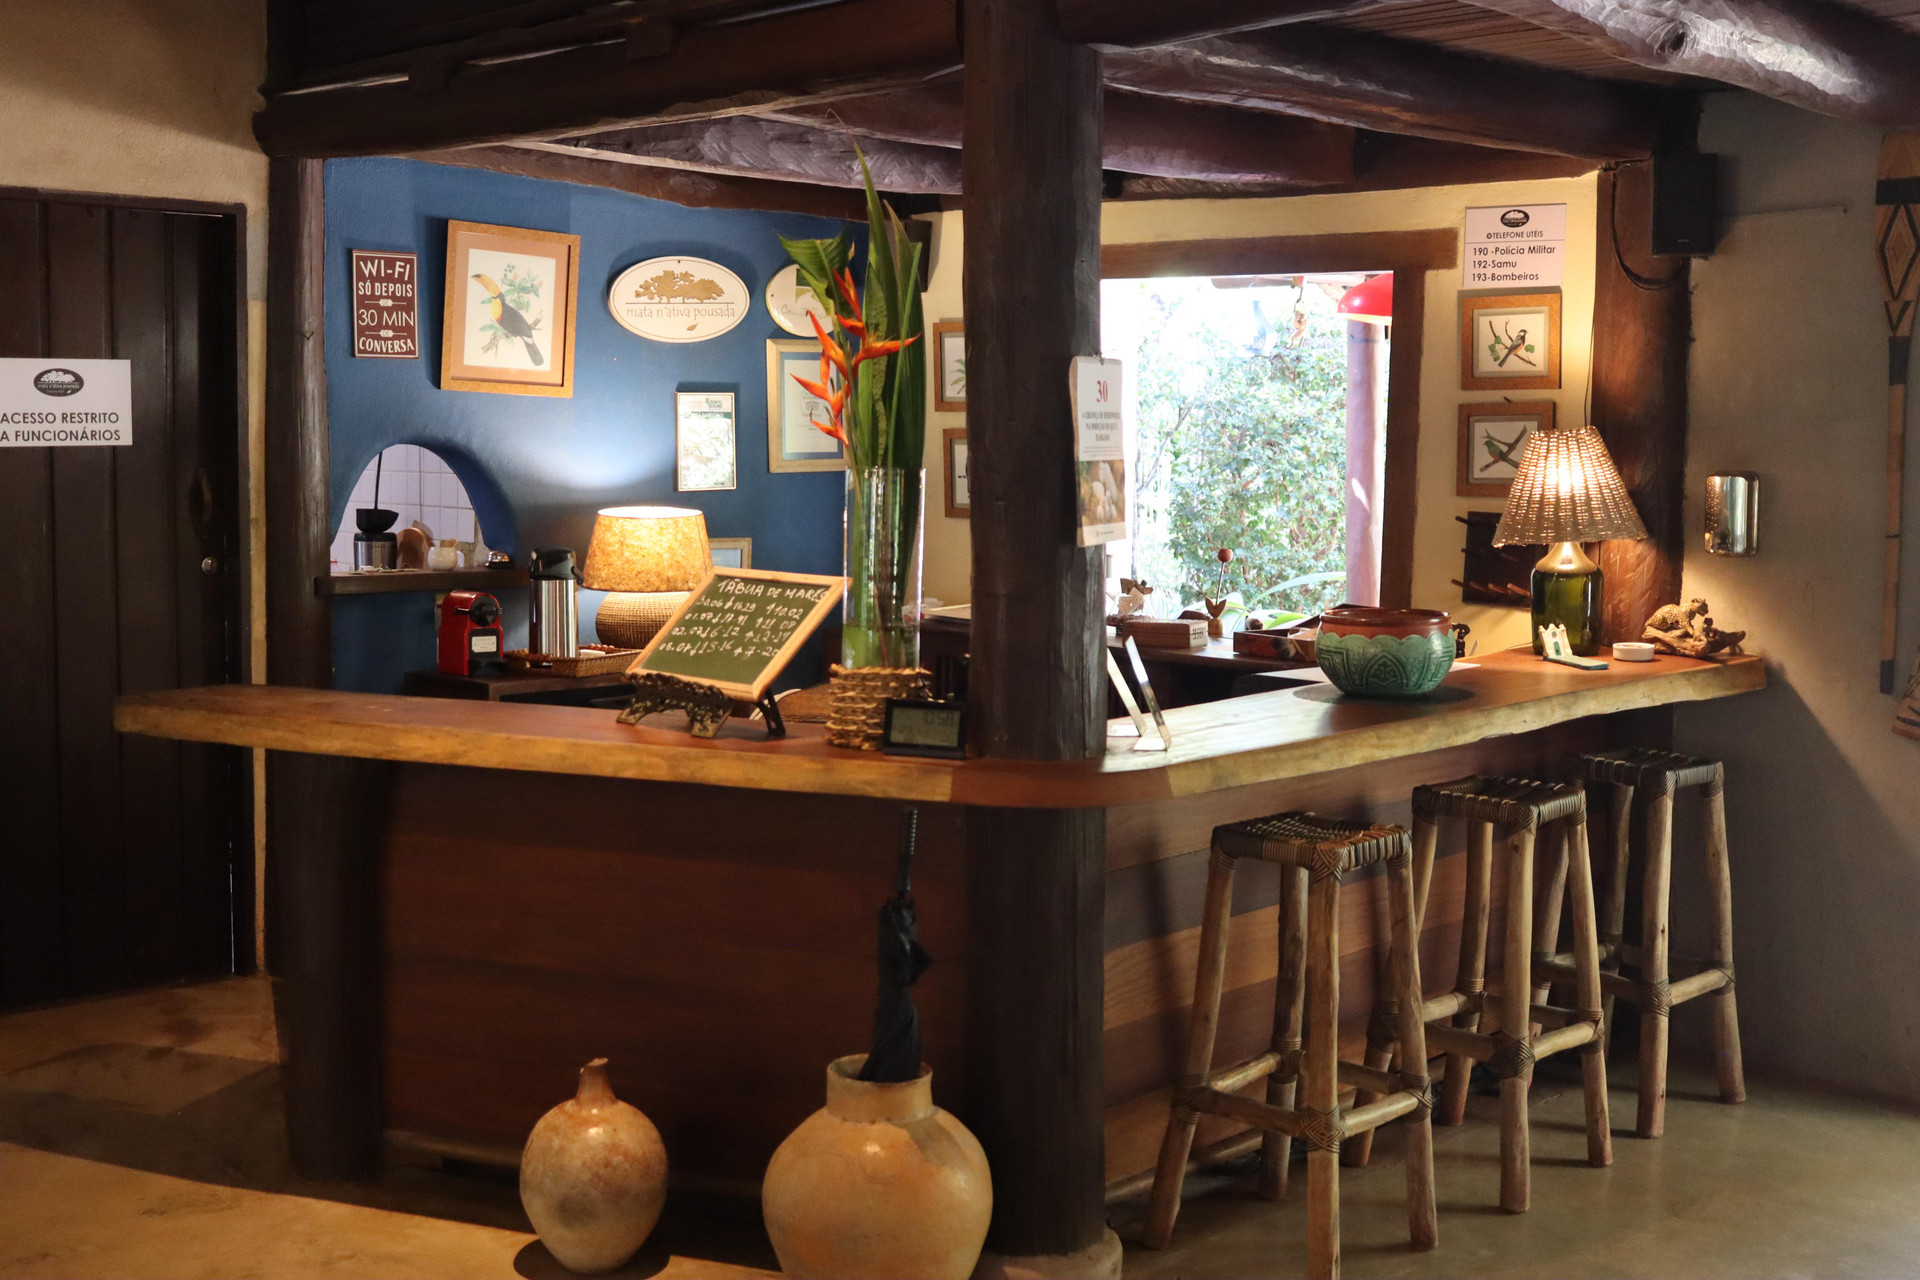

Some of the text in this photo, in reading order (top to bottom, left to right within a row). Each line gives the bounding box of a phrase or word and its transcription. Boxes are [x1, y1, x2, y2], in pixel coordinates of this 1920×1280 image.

[1473, 247, 1488, 256] 190
[1528, 245, 1556, 254] Militar
[360, 259, 411, 280] WI-FI
[1473, 260, 1517, 269] 192-Samu
[1472, 272, 1539, 282] 193-Bombeiros
[359, 280, 412, 297] SÓ DEPOIS
[359, 309, 414, 327] 30 MIN
[627, 306, 653, 318] mata
[694, 305, 735, 320] pousada
[359, 337, 414, 353] CONVERSA
[1096, 380, 1108, 403] 30
[0, 412, 119, 424] ACESSO RESTRITO
[0, 426, 121, 442] A FUNCIONÁRIOS
[767, 587, 782, 598] DE
